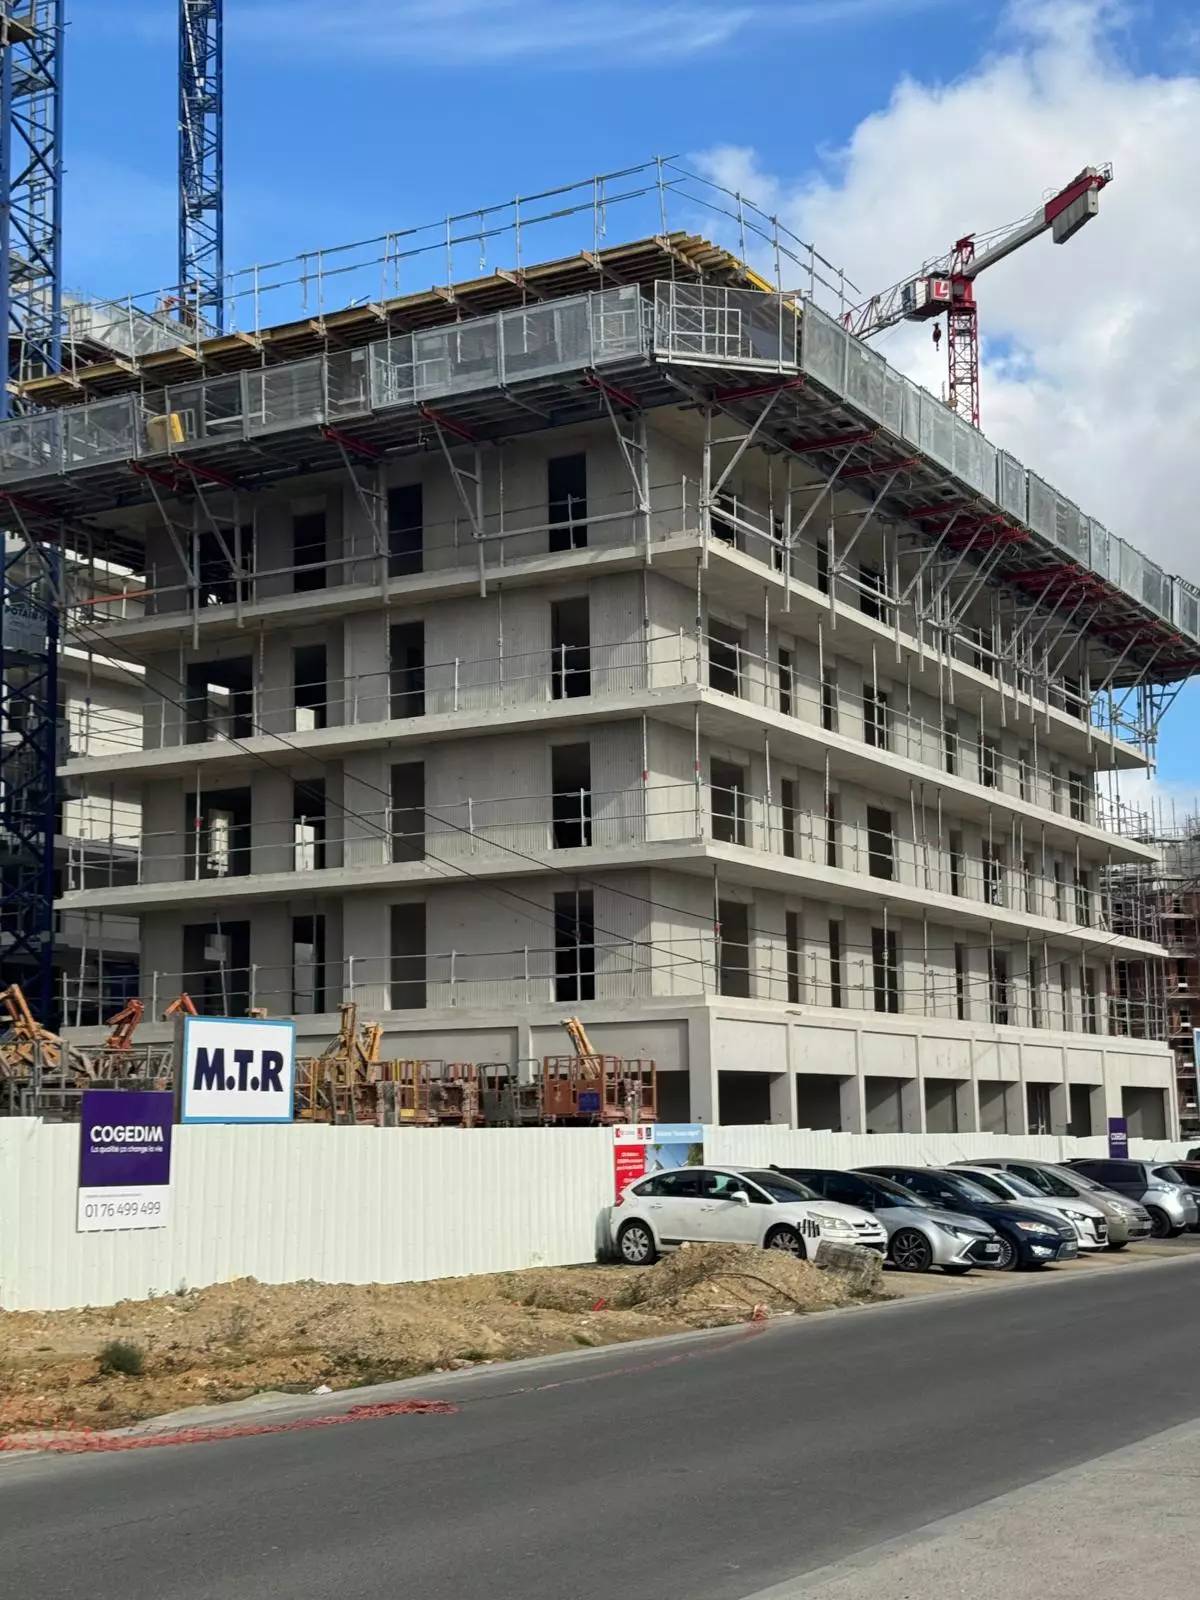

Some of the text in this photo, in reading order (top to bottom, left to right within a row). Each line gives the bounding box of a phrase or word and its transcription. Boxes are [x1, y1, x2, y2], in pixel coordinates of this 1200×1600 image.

[193, 1047, 284, 1092] M.T.R
[90, 1125, 164, 1143] COGEDIM
[101, 1202, 115, 1217] 76
[116, 1202, 138, 1216] 499
[140, 1201, 161, 1215] 499
